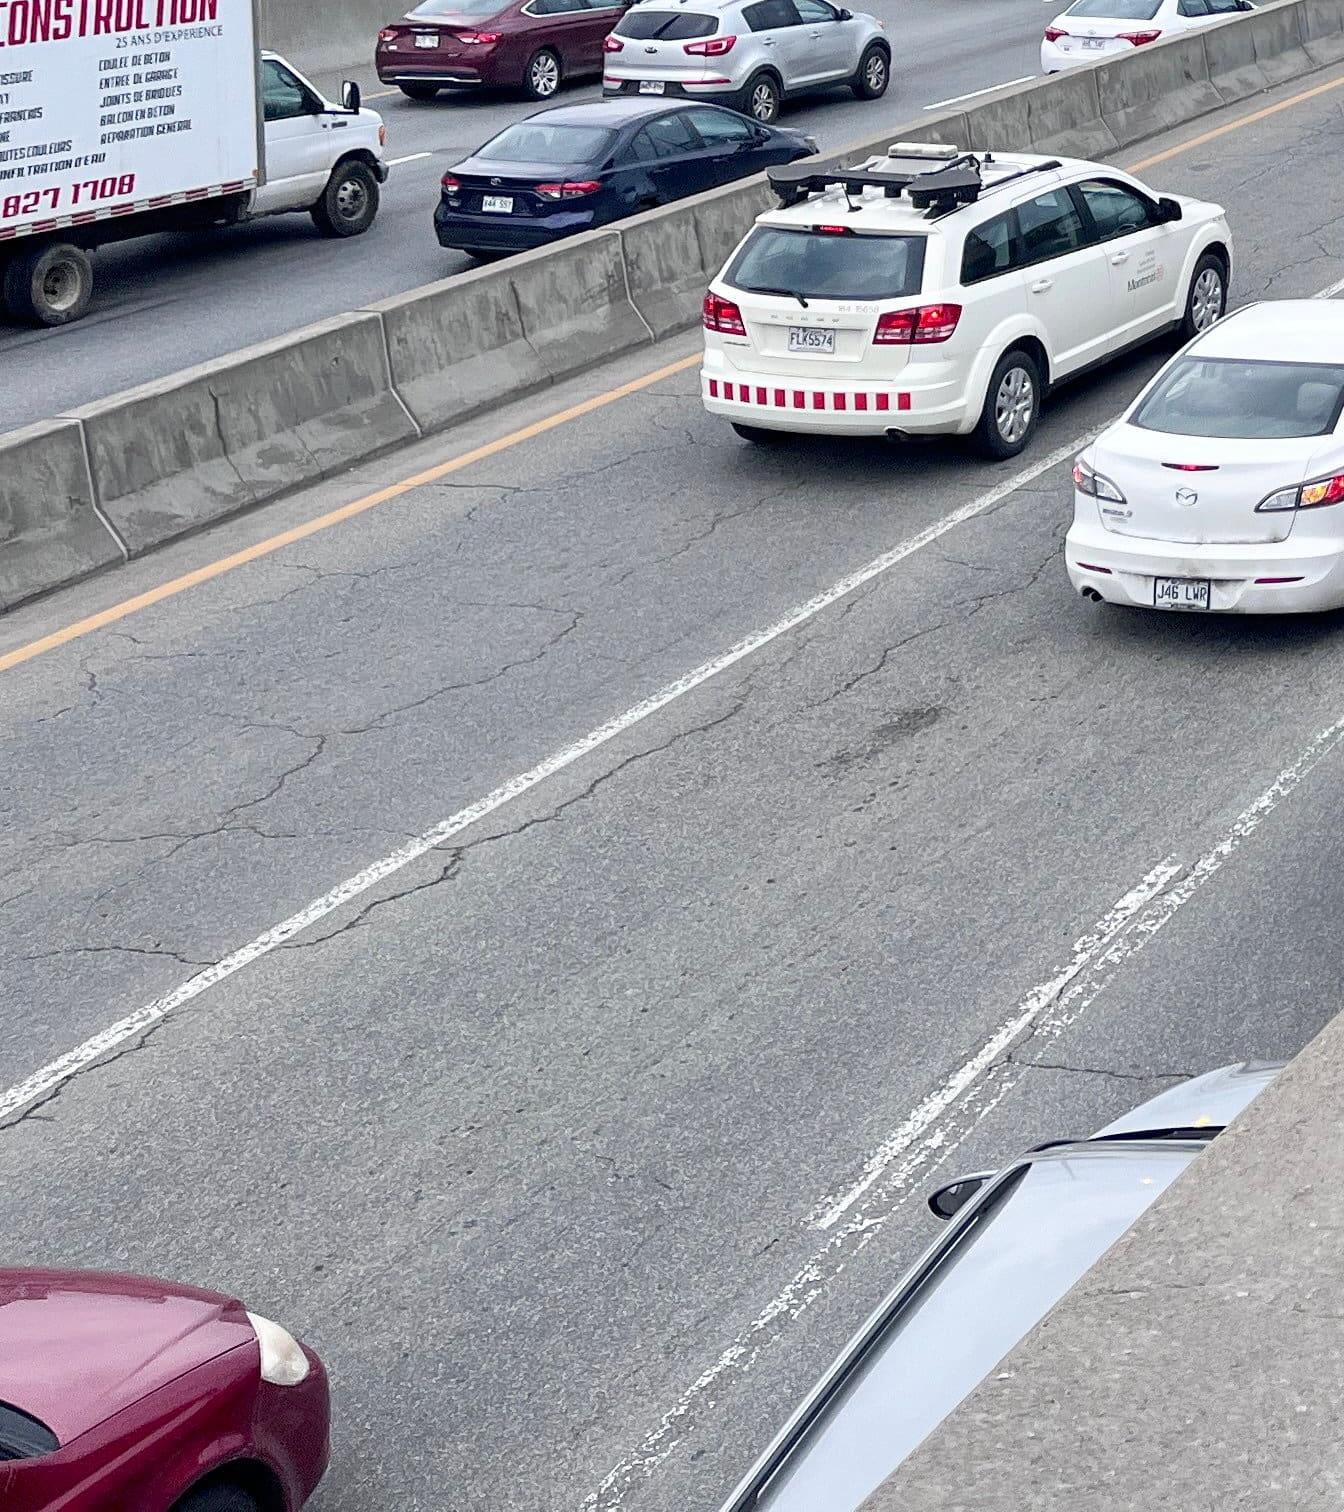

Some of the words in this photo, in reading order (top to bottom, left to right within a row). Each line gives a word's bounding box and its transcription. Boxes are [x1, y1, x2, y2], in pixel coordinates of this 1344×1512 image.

[115, 37, 128, 49] 25
[130, 35, 151, 47] ANS
[131, 55, 143, 67] DE
[134, 91, 144, 103] DE
[2, 187, 62, 219] 827
[71, 173, 136, 205] 1708
[1157, 584, 1179, 600] J46
[1186, 586, 1208, 601] LWR
